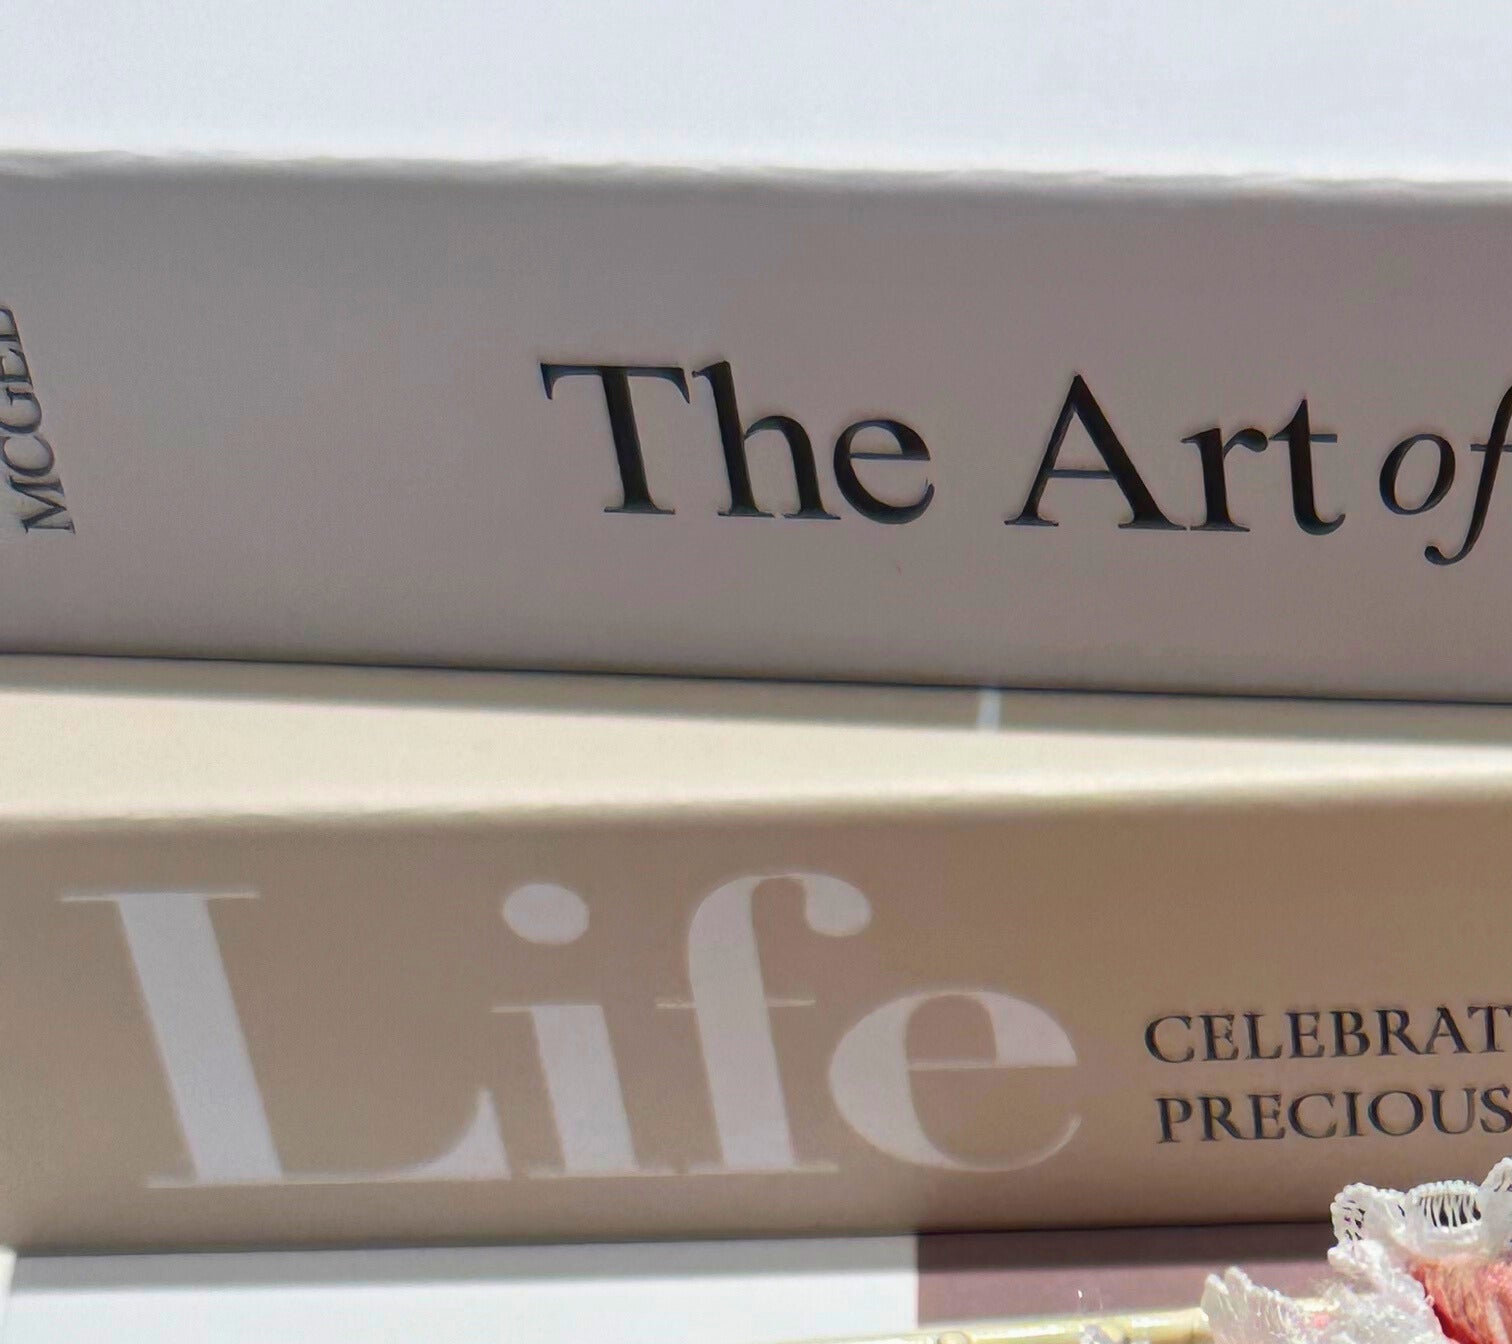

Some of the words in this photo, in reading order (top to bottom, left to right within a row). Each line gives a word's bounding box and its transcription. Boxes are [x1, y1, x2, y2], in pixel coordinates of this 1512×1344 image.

[540, 360, 936, 526] The
[1003, 373, 1346, 537] Art
[57, 871, 1083, 1189] Life
